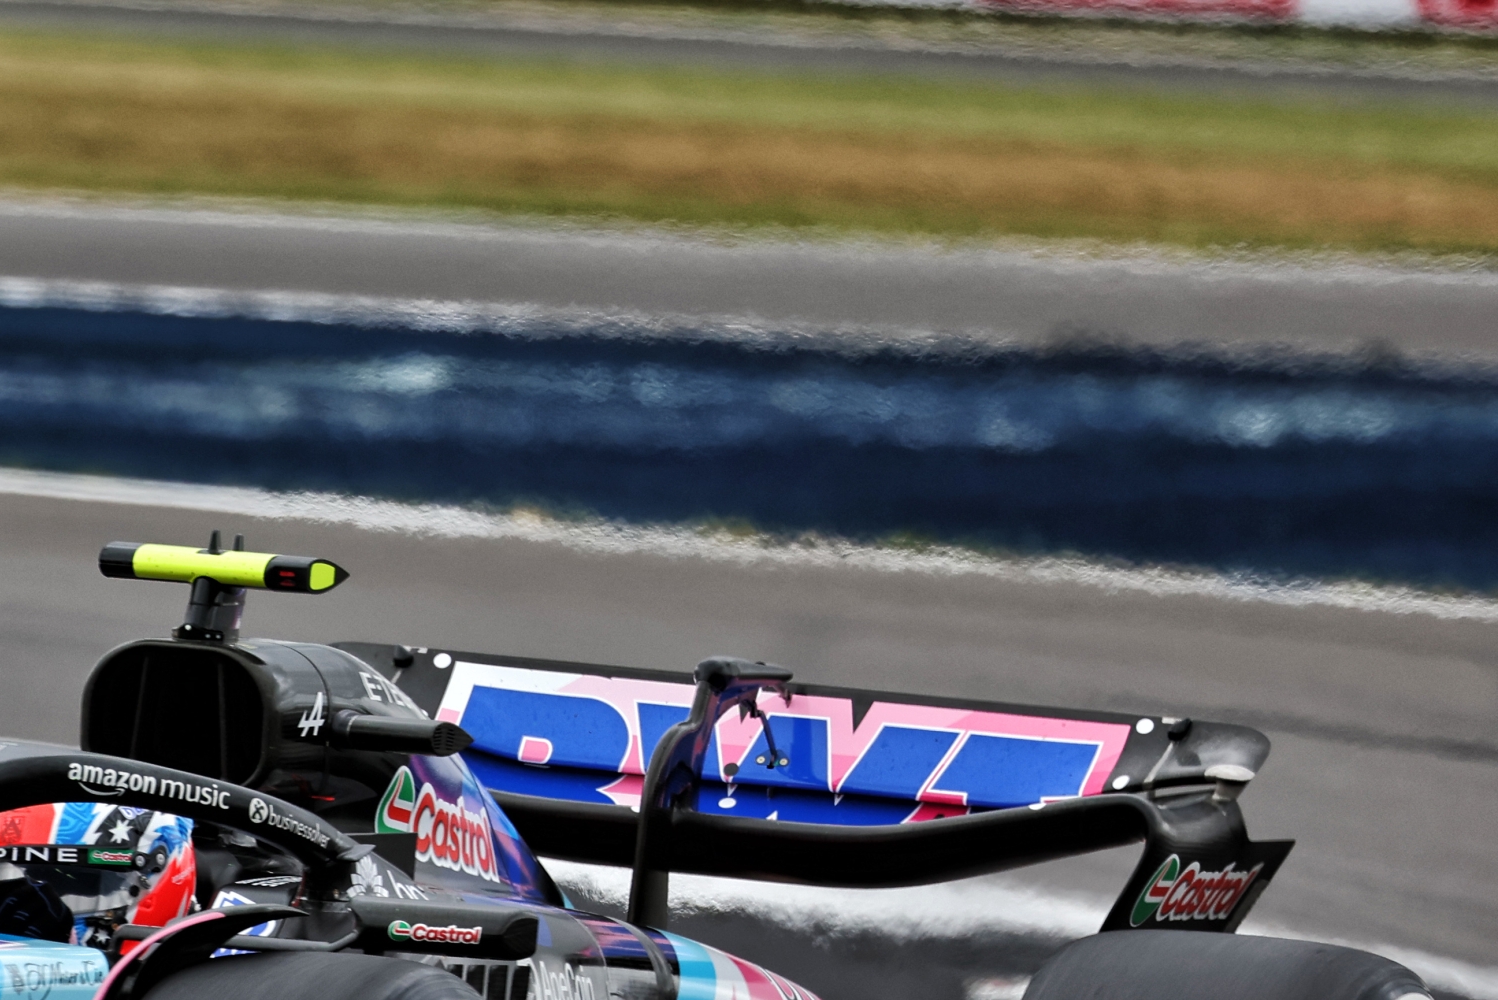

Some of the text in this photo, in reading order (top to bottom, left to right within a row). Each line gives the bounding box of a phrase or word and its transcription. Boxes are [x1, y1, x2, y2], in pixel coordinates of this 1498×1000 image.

[68, 762, 231, 810] amazon music
[268, 804, 331, 850] businessolver
[412, 783, 500, 883] Castrol
[1156, 861, 1264, 922] Castrol
[408, 924, 483, 945] Castrol
